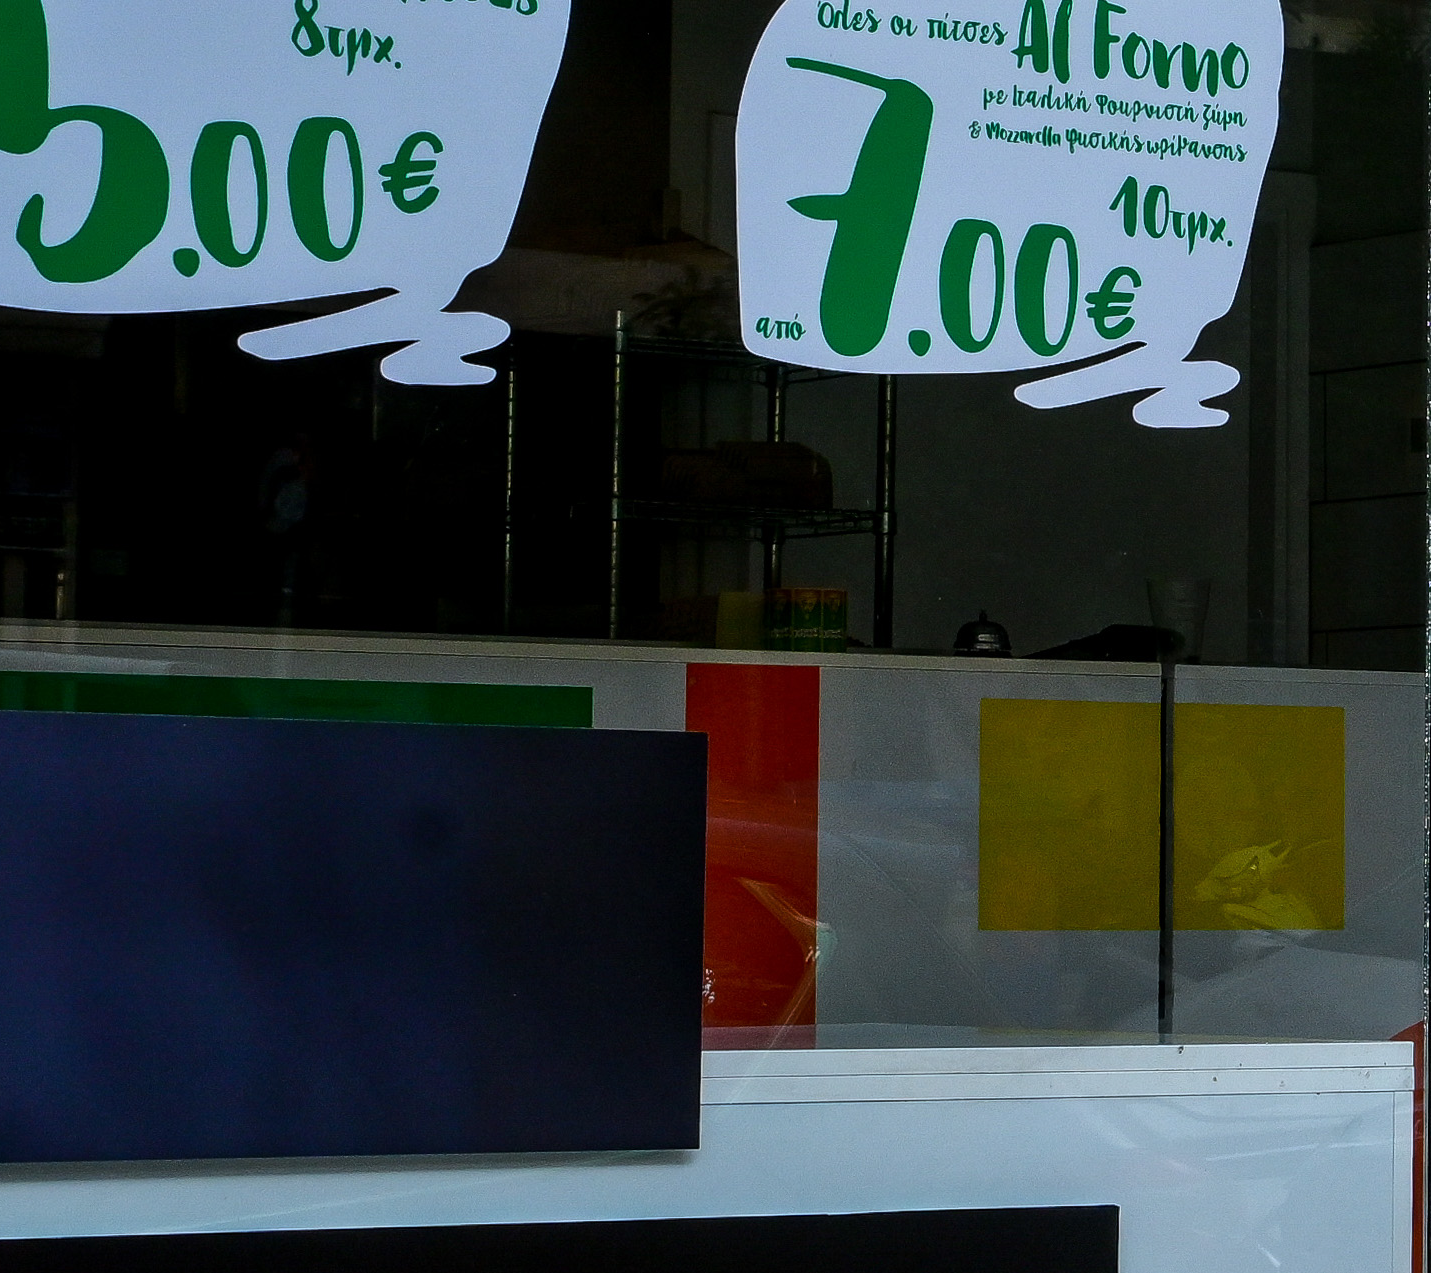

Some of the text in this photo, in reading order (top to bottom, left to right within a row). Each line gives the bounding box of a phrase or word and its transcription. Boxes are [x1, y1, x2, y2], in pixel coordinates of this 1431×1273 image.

[891, 16, 917, 36] οι
[927, 13, 1008, 45] πίτσες
[1094, 0, 1249, 97] Forno
[985, 121, 1061, 147] Mozzarella
[755, 314, 807, 342] από
